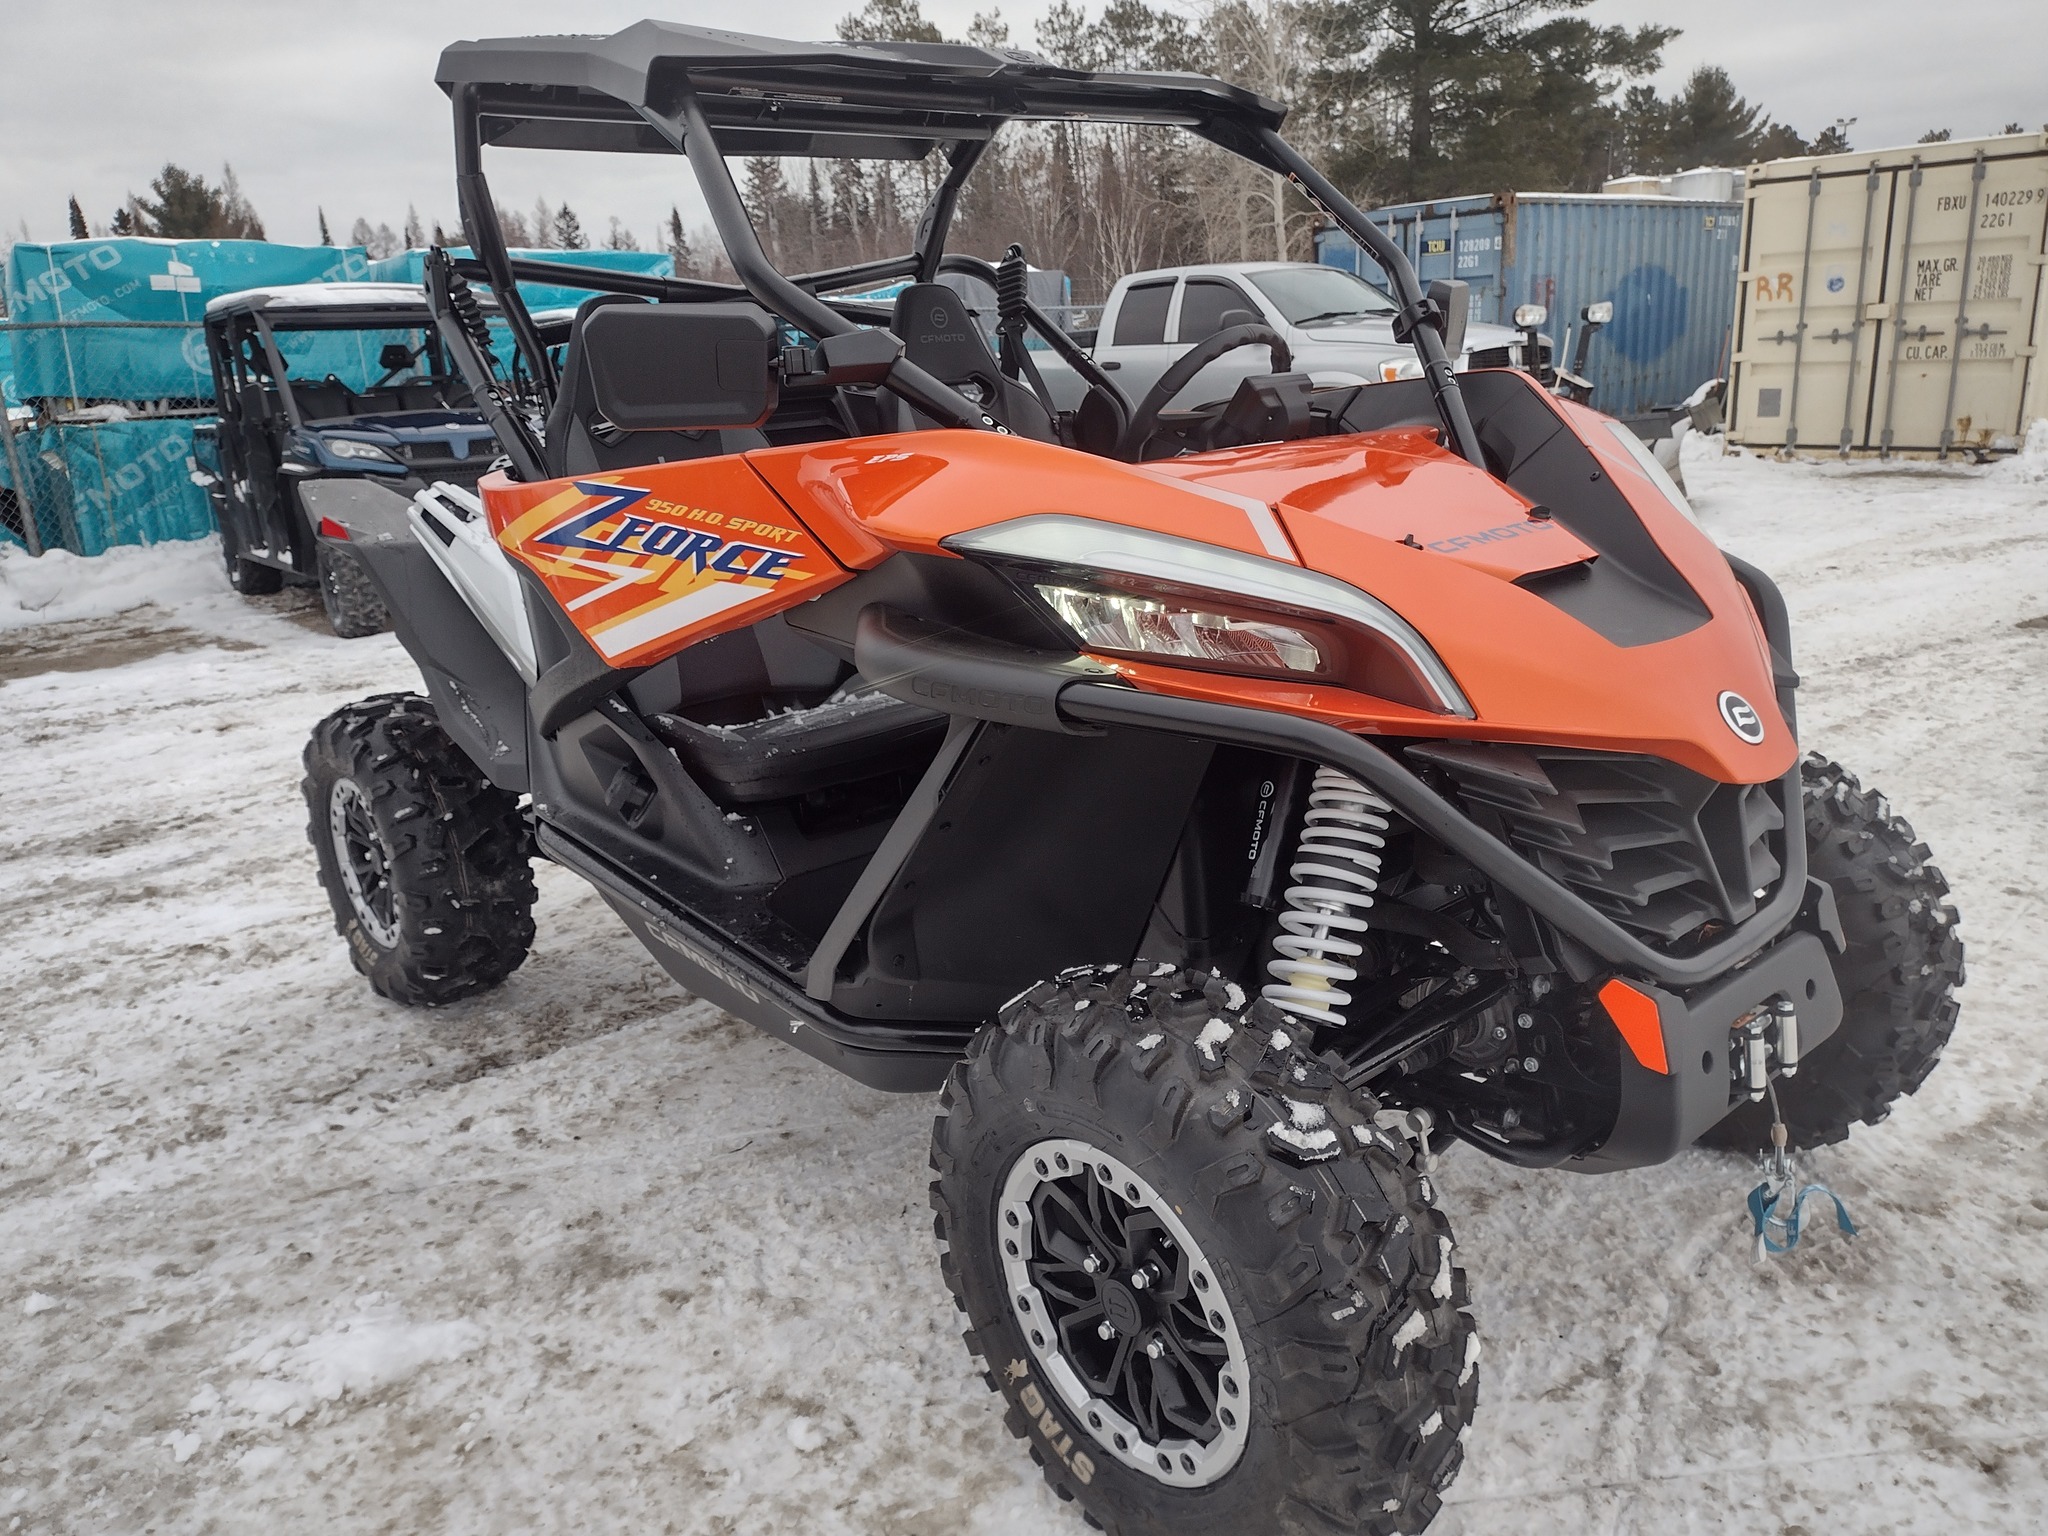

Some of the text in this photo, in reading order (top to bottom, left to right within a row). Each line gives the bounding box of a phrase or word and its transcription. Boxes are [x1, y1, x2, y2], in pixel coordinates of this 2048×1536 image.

[1937, 196, 1967, 211] FBXU
[1917, 273, 1942, 287] TARE
[1914, 287, 1934, 301] NET
[920, 332, 966, 344] CFMOTO
[863, 452, 916, 465] EPS
[644, 498, 690, 517] 950
[726, 516, 804, 544] SPORT
[1427, 520, 1555, 554] CFMOTO
[911, 675, 1049, 715] CFMOTO
[1248, 800, 1267, 861] CFMOTO
[1018, 1384, 1097, 1486] STAG
